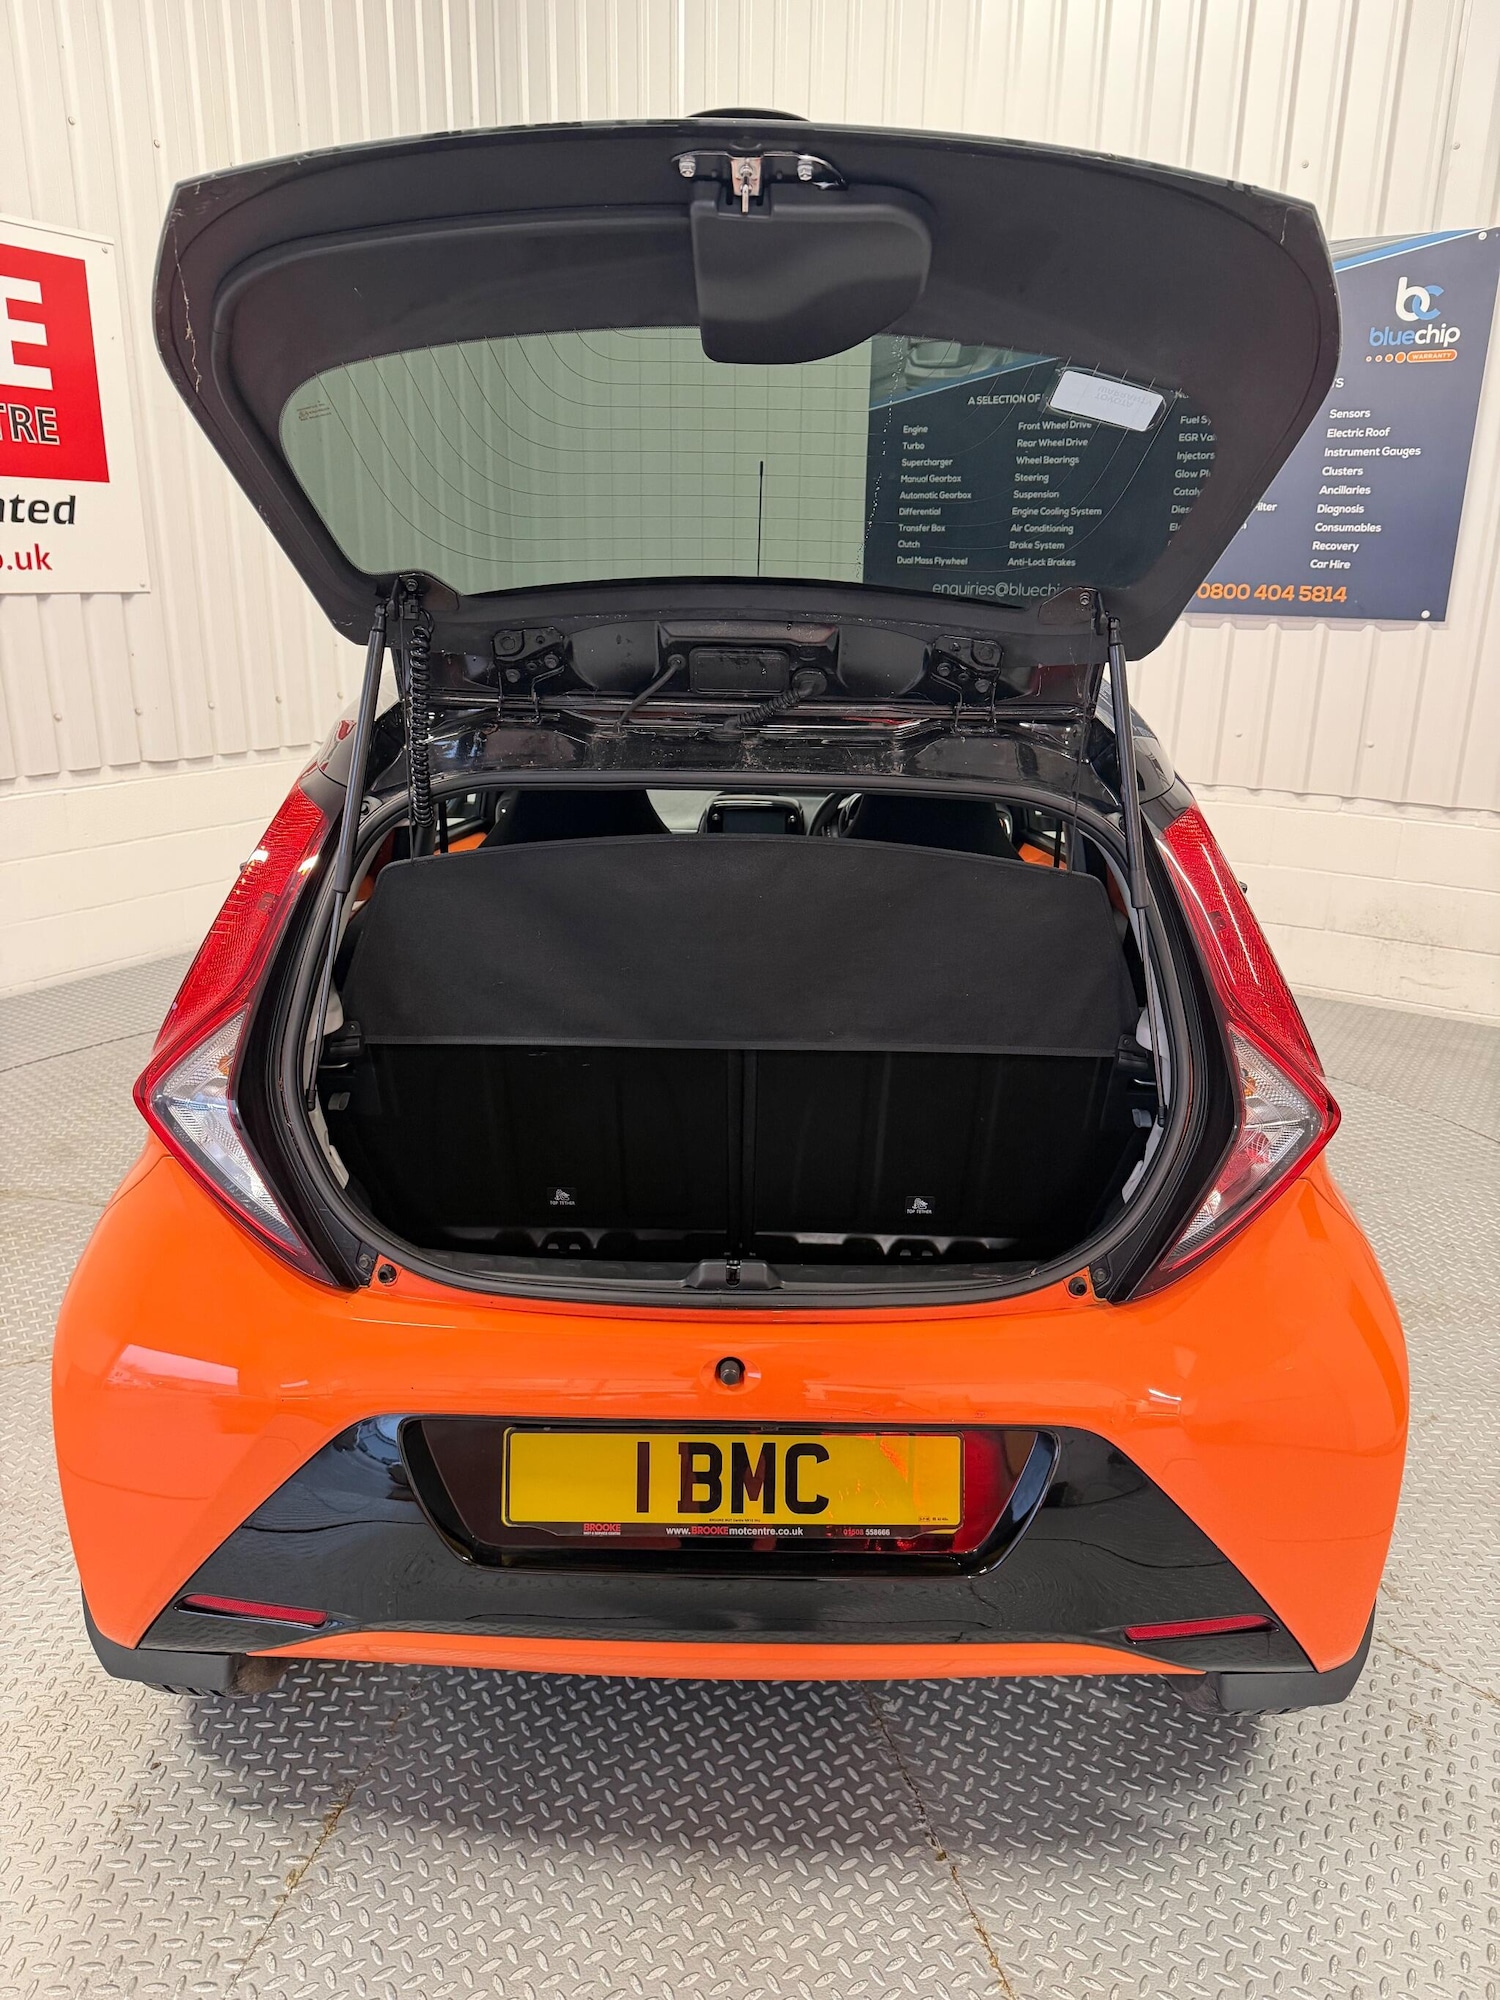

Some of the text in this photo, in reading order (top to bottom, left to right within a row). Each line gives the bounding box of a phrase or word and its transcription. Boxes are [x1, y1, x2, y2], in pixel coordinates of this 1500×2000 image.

[1369, 323, 1460, 347] bluechip
[967, 397, 975, 405] A
[976, 394, 1027, 405] SELECTION
[1027, 393, 1041, 403] OF
[1329, 409, 1371, 418] Sensors
[1018, 420, 1092, 430] Front Wheel Drive
[1180, 416, 1200, 424] Fuel
[903, 425, 928, 436] Engine
[1327, 427, 1391, 438] Electric Roof
[1179, 433, 1198, 442] EGR
[902, 442, 925, 450] Turbo
[1017, 438, 1088, 448] Rear Wheel Drive
[1177, 452, 1215, 463] Injectors
[1324, 446, 1421, 459] Instrument Gauges
[901, 458, 953, 469] Supercharger
[1016, 456, 1080, 467] Wheel Bearings
[1174, 469, 1198, 478] Glow
[1321, 466, 1364, 476] Clusters
[900, 474, 961, 483] Manual Gearbox
[1015, 473, 1049, 484] Steering
[900, 491, 972, 499] Automatic Gearbox
[1013, 490, 1059, 500] Suspension
[1319, 485, 1371, 495] Ancillaries
[899, 507, 941, 516] Differential
[1255, 502, 1277, 511] ilter
[1317, 504, 1365, 516] Diagnosis
[1012, 507, 1102, 518] Engine Cooling System
[899, 524, 945, 532] Transfer Box
[1010, 524, 1074, 535] Air Conditioning
[1314, 522, 1382, 532] Consumables
[898, 540, 920, 548] Clutch
[1009, 541, 1065, 551] Brake System
[1312, 541, 1359, 552] Recovery
[896, 556, 968, 566] Dual Mass Flywheel
[1007, 557, 1076, 566] Anti-Lock Brakes
[1310, 559, 1351, 569] Car Hire
[1196, 583, 1347, 603] 0800 404 5814
[678, 1442, 829, 1514] BMC
[583, 1523, 621, 1532] BROOKE
[666, 1526, 803, 1536] www.BROOKEmotcentre.co.uk
